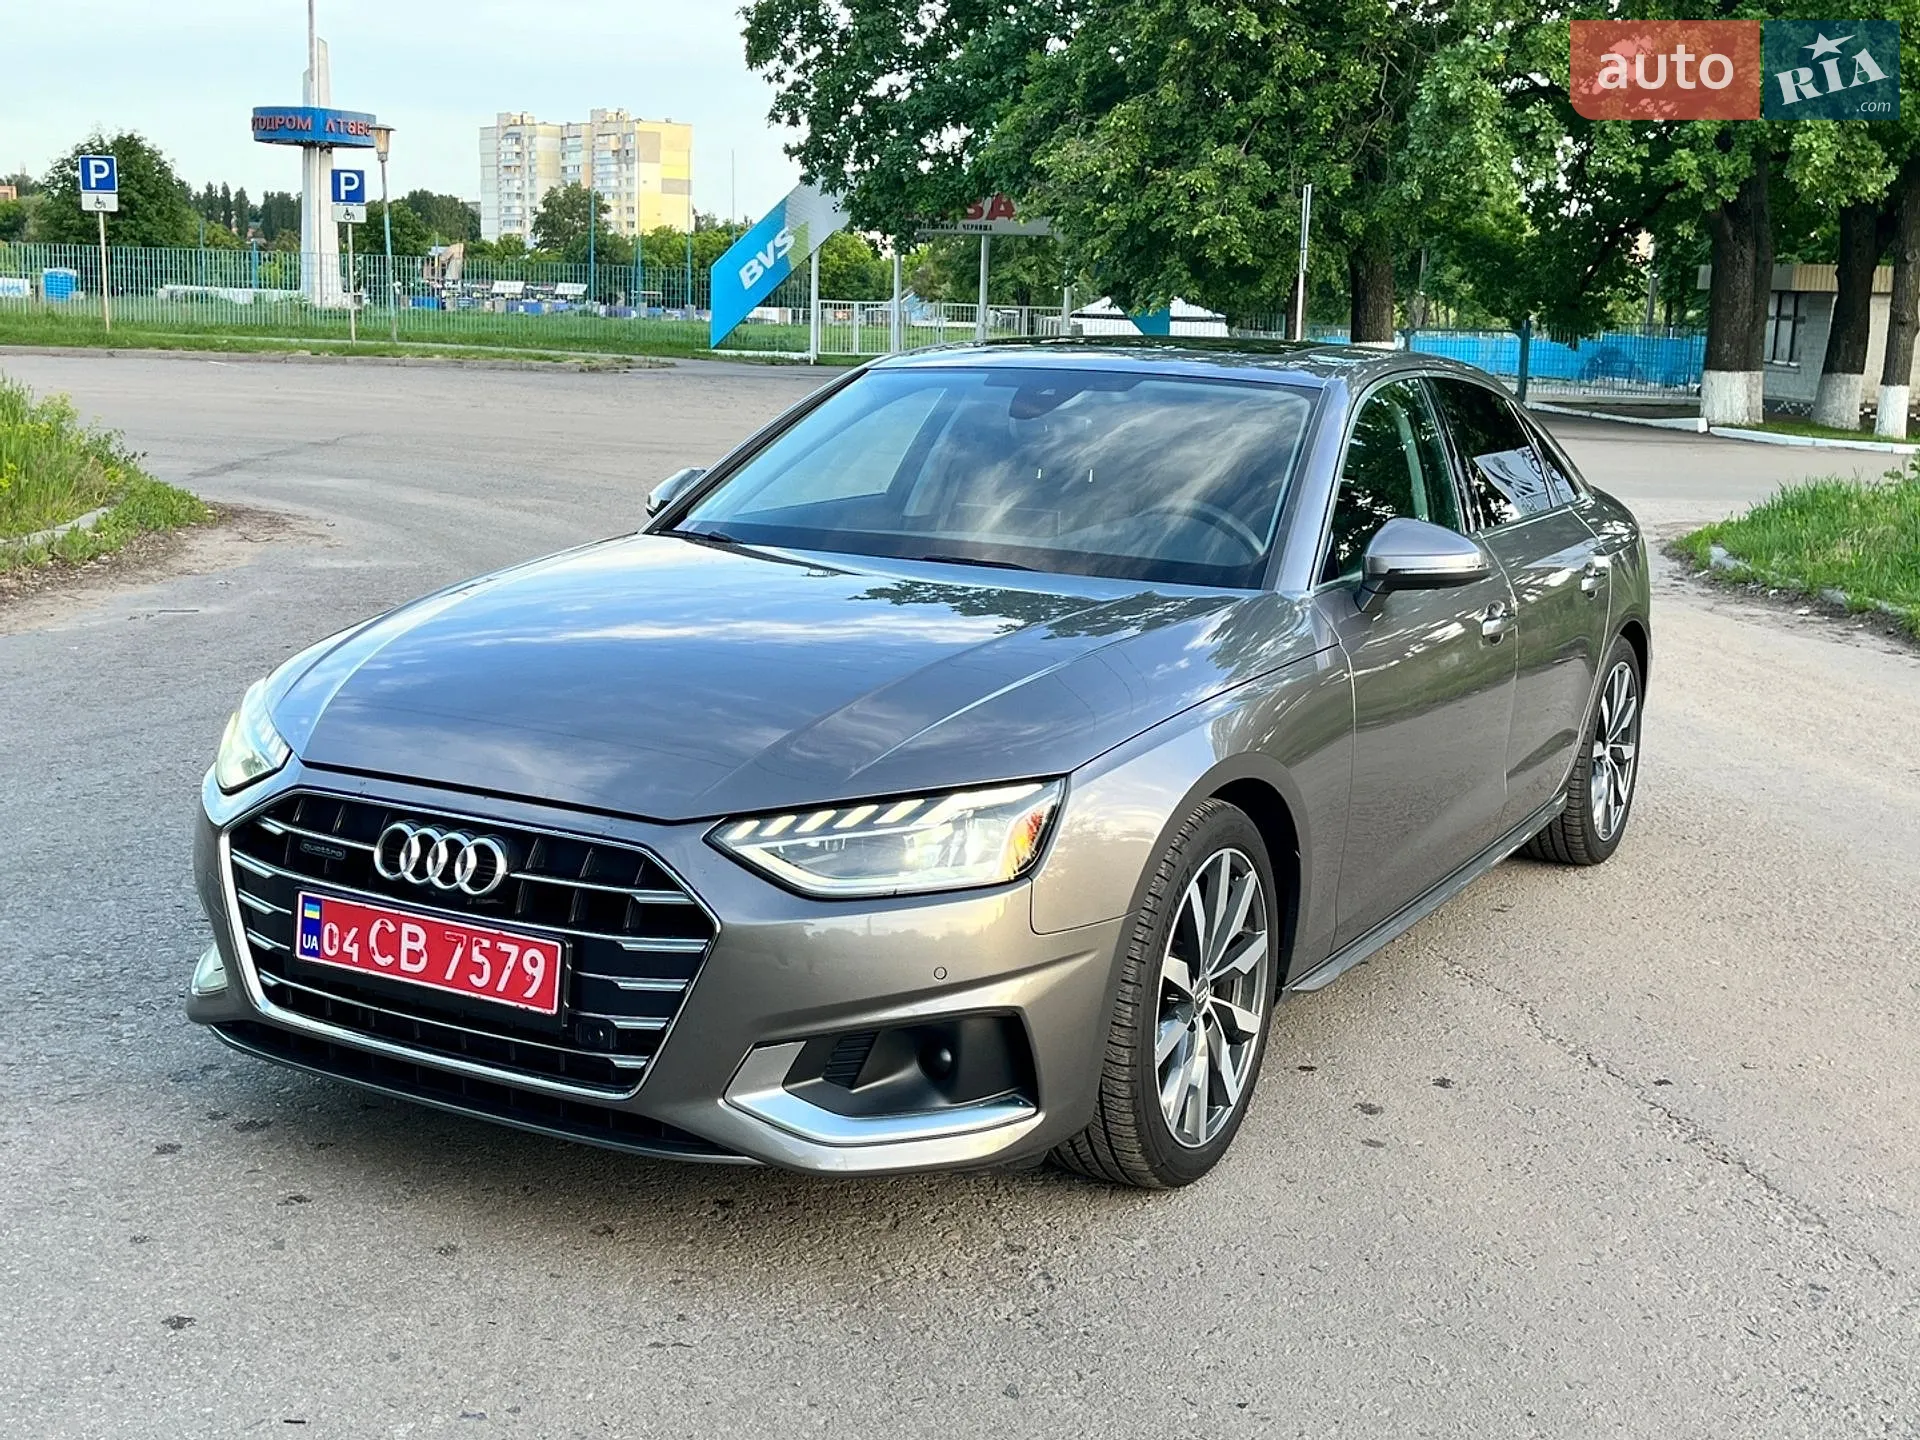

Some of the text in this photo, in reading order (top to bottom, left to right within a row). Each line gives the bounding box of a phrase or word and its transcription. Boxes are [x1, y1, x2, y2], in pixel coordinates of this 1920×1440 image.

[88, 159, 109, 189] P
[339, 172, 360, 200] P
[739, 226, 795, 290] BVS
[303, 843, 343, 857] quattro
[302, 933, 319, 951] UA
[322, 918, 546, 999] 04 CB 7579
